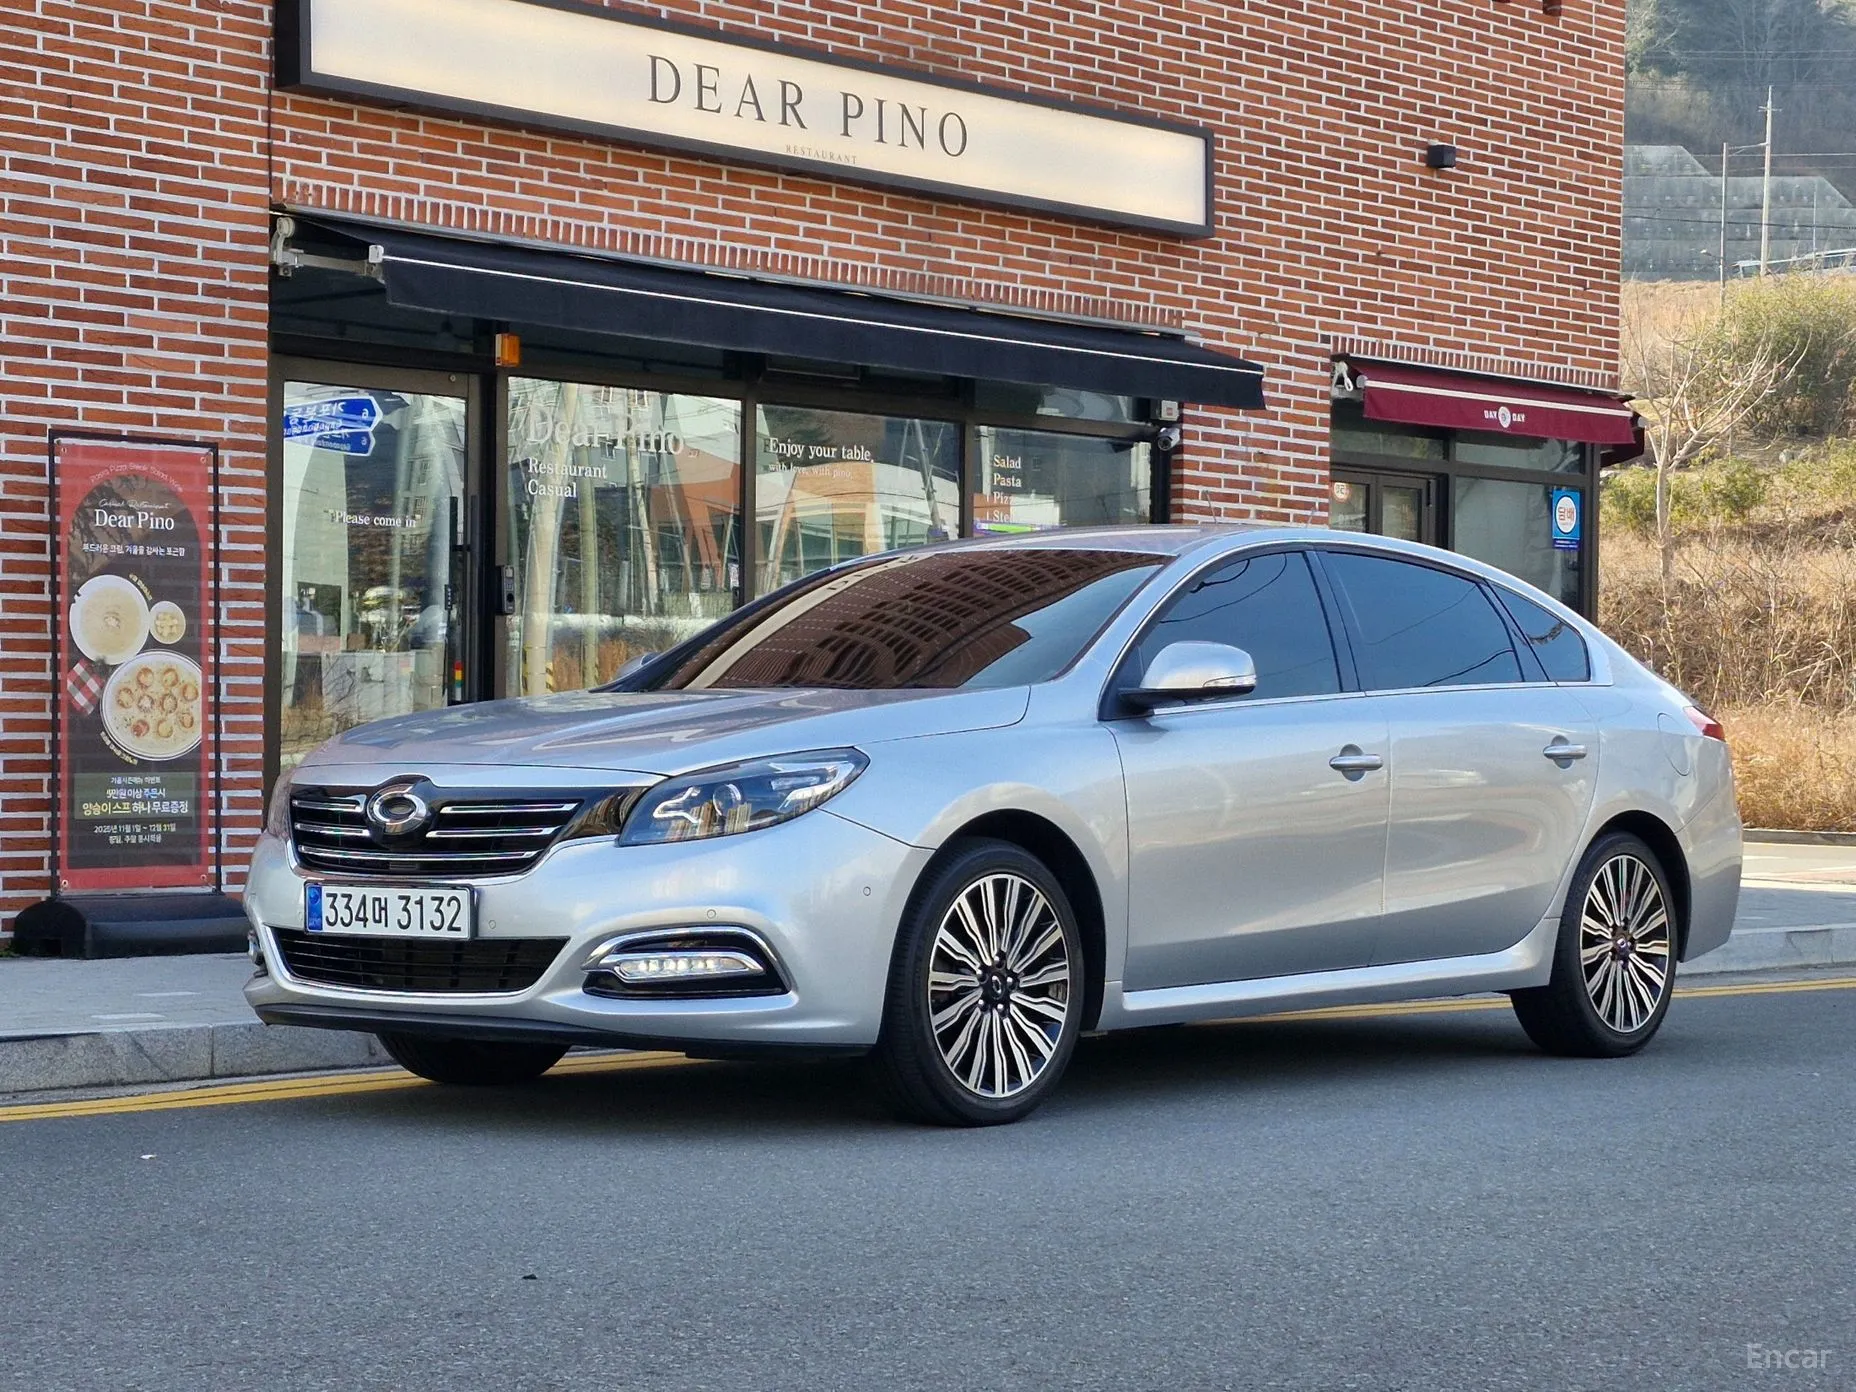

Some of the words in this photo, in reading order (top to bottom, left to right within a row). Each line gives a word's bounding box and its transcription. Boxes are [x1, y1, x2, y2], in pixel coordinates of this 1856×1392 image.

[646, 54, 808, 130] DEAR
[839, 90, 968, 158] PINO
[785, 144, 858, 165] RESTAURANT
[769, 437, 805, 459] Enjoy
[808, 444, 838, 460] your
[528, 456, 608, 479] Restaurant
[993, 454, 1022, 469] Salad
[528, 479, 577, 498] Casual
[993, 472, 1022, 488] Pasta
[95, 508, 135, 529] Dear
[137, 511, 175, 531] Pino
[373, 516, 402, 527] come
[325, 892, 388, 929] 334머
[396, 894, 462, 932] 3132
